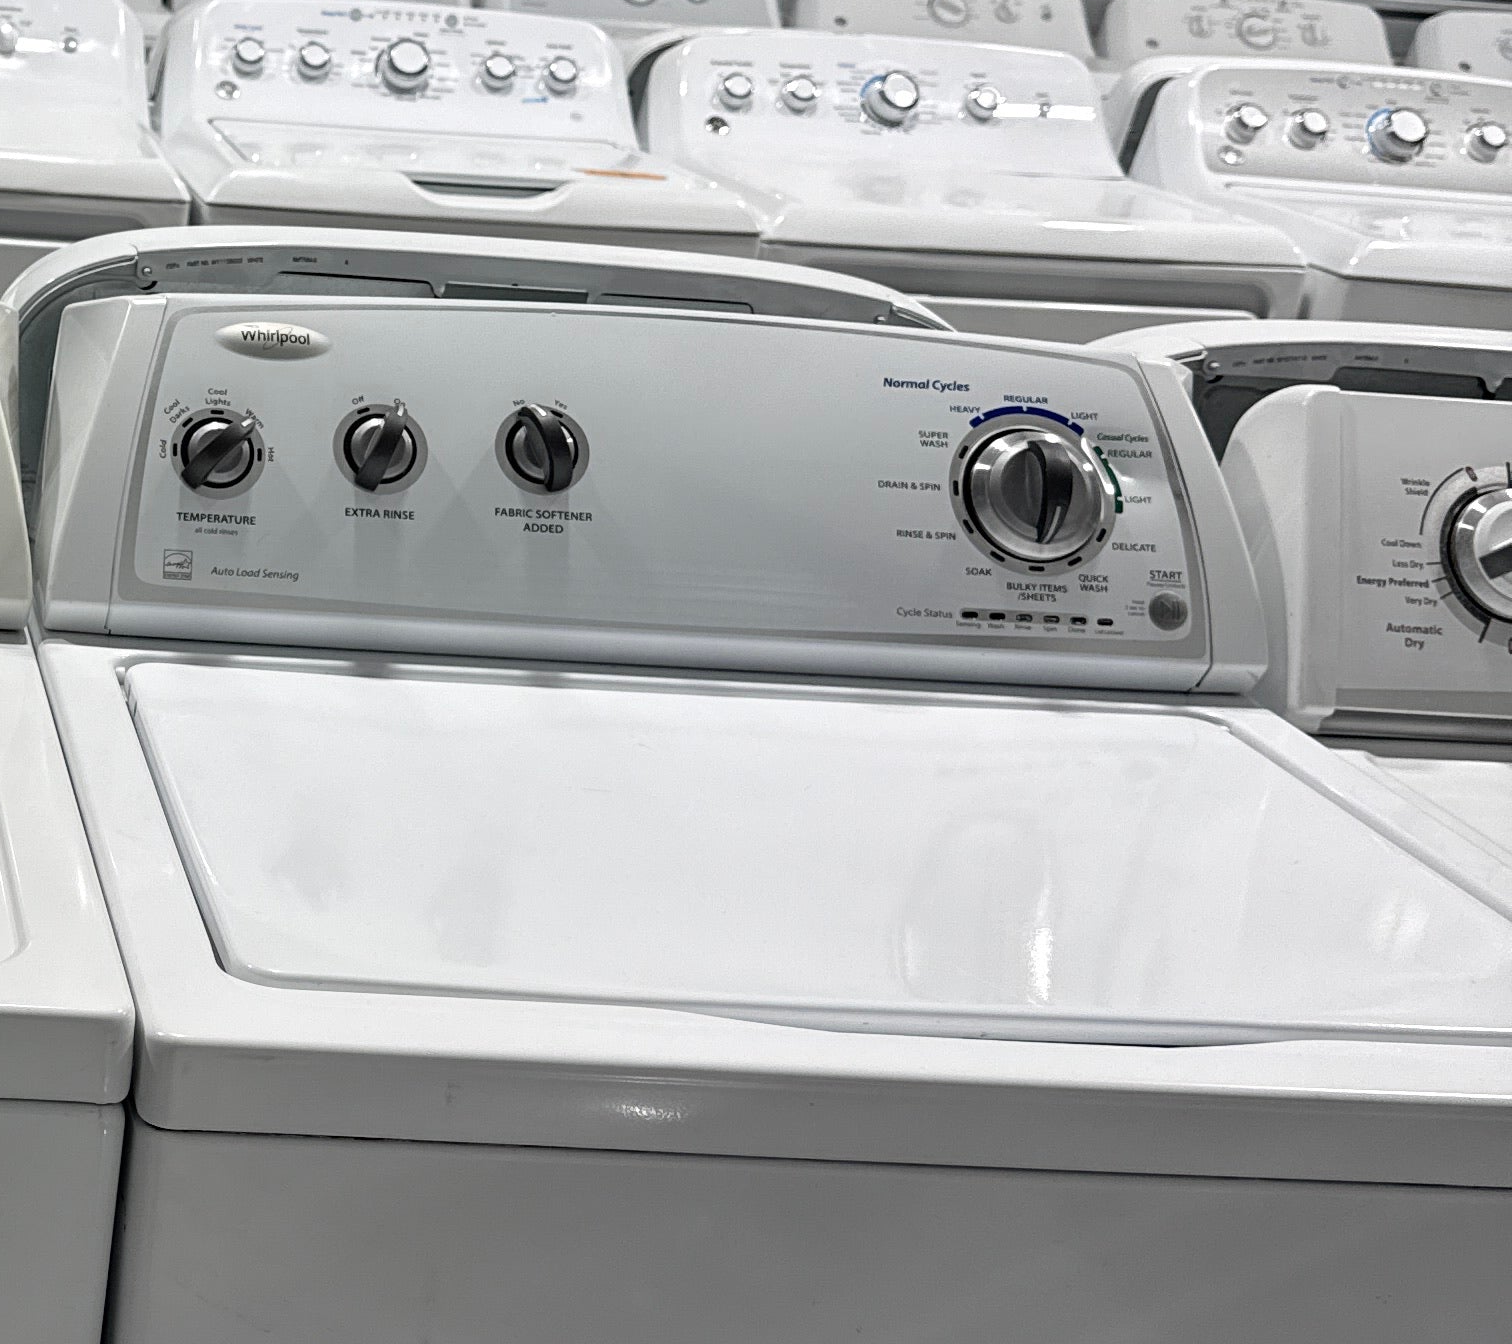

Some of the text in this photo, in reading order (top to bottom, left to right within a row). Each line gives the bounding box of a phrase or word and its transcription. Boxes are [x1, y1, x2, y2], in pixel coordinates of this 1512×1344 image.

[241, 330, 310, 347] Whirlpool
[883, 377, 970, 393] Normal Cycles
[207, 388, 228, 396] Cool
[205, 398, 231, 407] Lights
[352, 395, 365, 406] Off
[513, 398, 526, 407] No
[1003, 394, 1048, 404] REGULAR
[163, 399, 181, 415] Cool
[553, 399, 568, 411] Yes
[949, 405, 980, 414] HEAVY
[169, 406, 190, 424] Darks
[1070, 411, 1098, 421] LIGHT
[918, 430, 949, 440] SUPER
[1125, 434, 1149, 444] Cycles
[159, 439, 167, 459] Cold
[919, 439, 948, 448] WASH
[1107, 449, 1153, 459] REGULAR
[877, 480, 941, 491] DRAIN & SPIN
[1124, 495, 1152, 505] LIGHT
[176, 511, 256, 526] TEMPERATURE
[344, 507, 415, 520] EXTRA RINSE
[494, 507, 593, 522] FABRIC SOFTENER
[523, 523, 564, 534] ADDED
[896, 529, 957, 541] RINSE & SPIN
[1111, 542, 1157, 553] DELICATE
[1409, 559, 1424, 570] Dry
[210, 567, 300, 582] Auto Load Sensing
[965, 567, 992, 576] SOAK
[1149, 569, 1183, 580] START
[1078, 573, 1109, 584] QUICK
[1356, 575, 1430, 589] Energy Preferred
[1006, 581, 1068, 593] BULKY ITEMS
[1079, 583, 1108, 593] WASH
[1018, 592, 1057, 603] /SHEETS
[1405, 595, 1422, 606] Very
[896, 606, 953, 619] Cycle Status
[1386, 622, 1443, 637] Automatic
[1404, 637, 1425, 651] Dry
